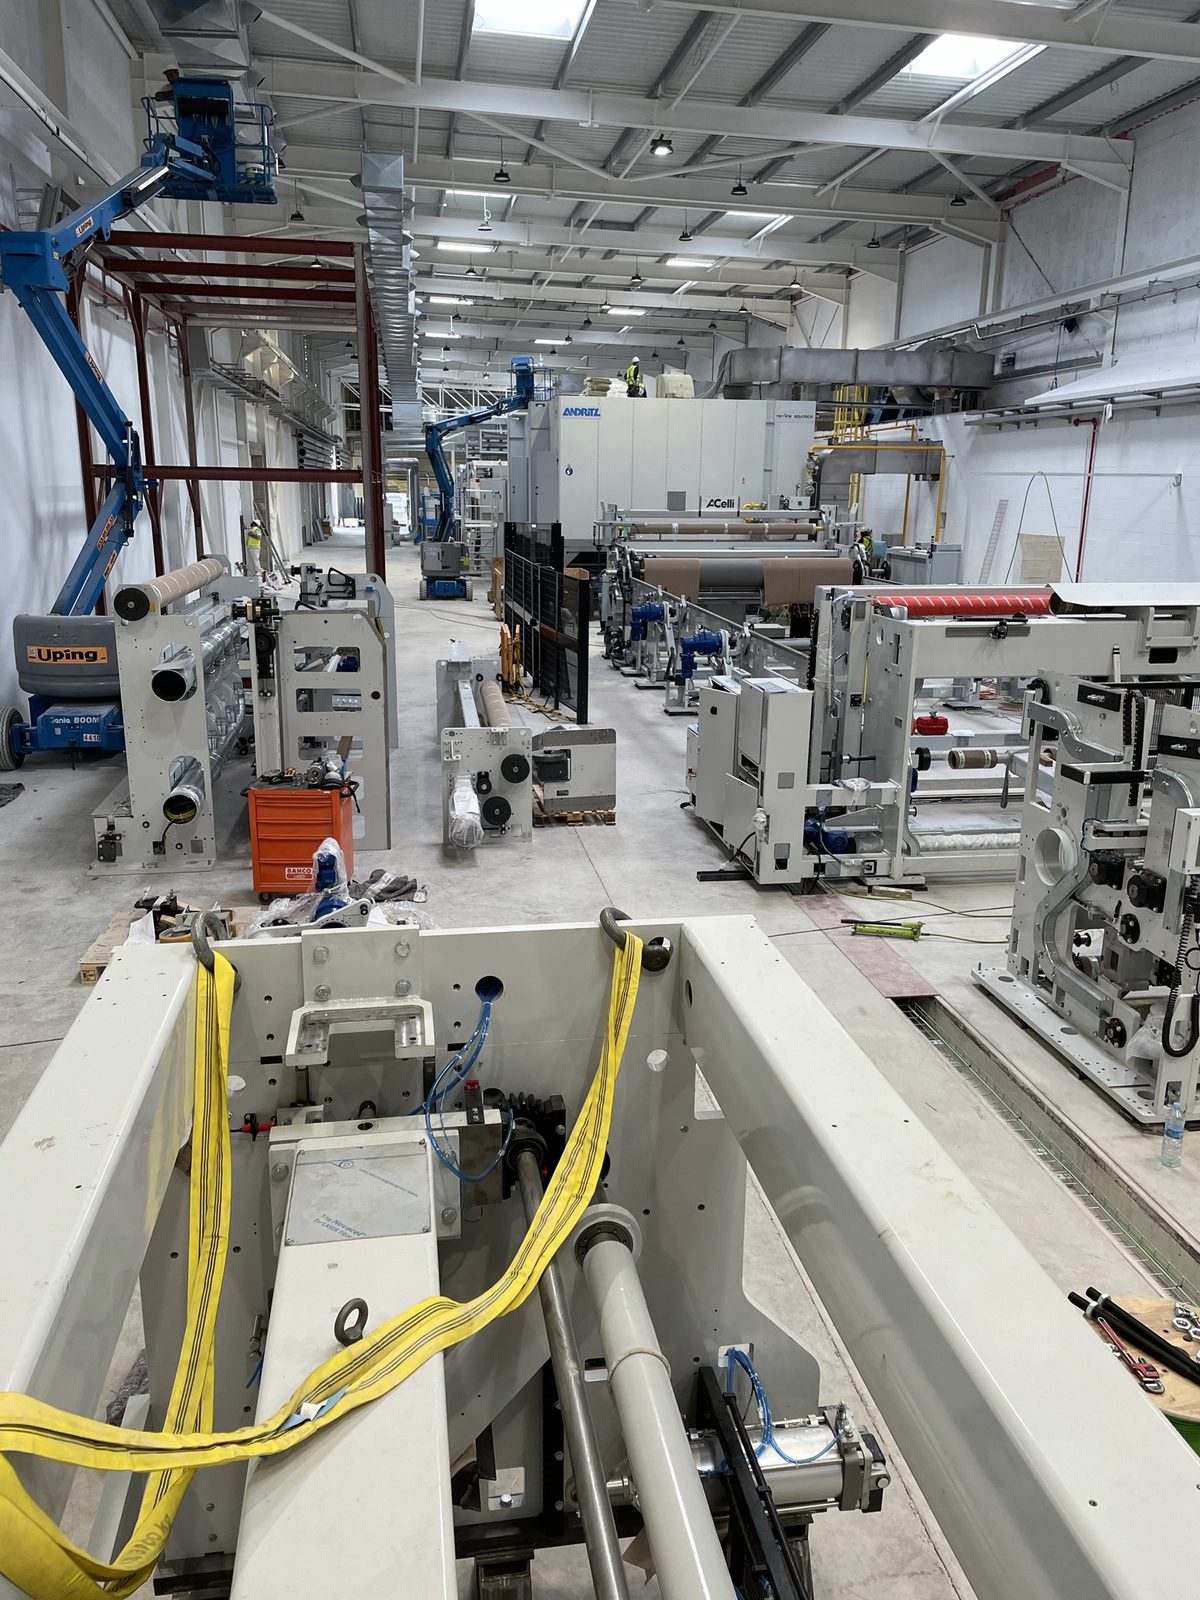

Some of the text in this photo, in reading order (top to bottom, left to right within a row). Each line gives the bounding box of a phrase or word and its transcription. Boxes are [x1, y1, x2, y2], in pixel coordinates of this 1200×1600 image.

[562, 407, 601, 416] ANDRITZ
[706, 498, 735, 508] ACelli
[37, 648, 98, 662] Uping
[73, 716, 100, 724] BOOM
